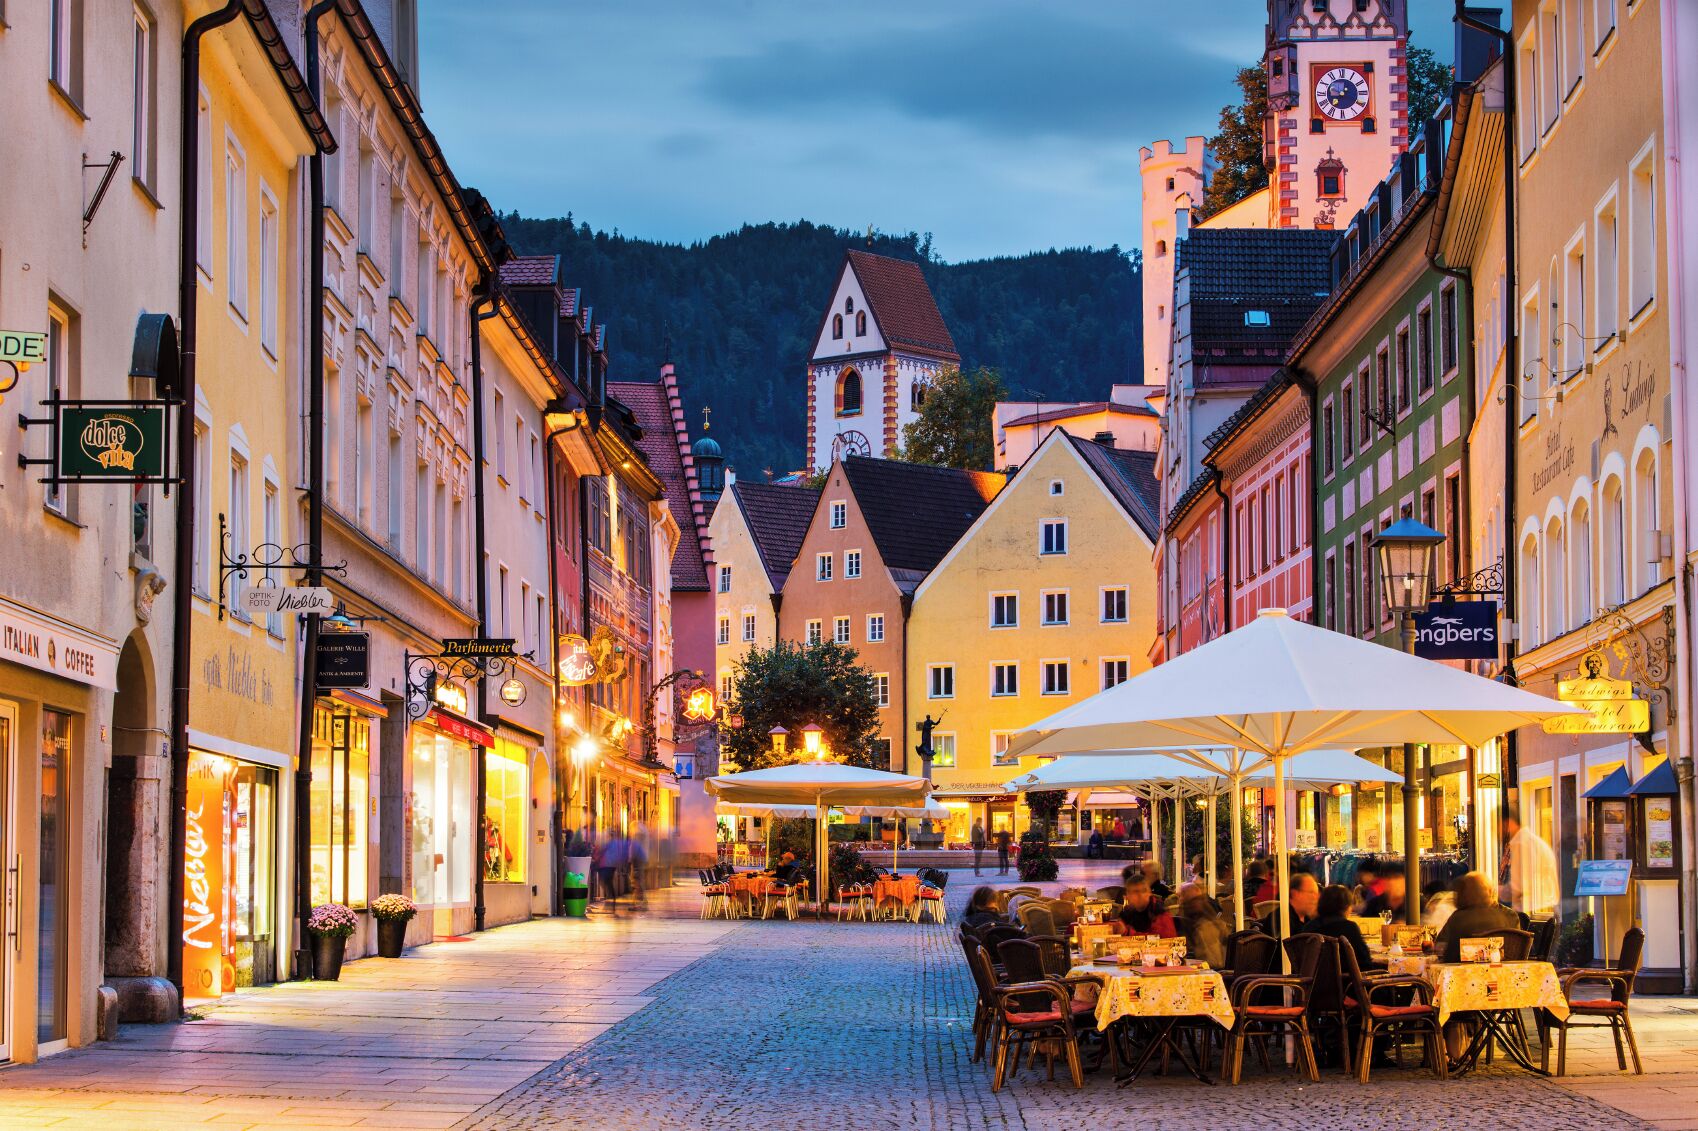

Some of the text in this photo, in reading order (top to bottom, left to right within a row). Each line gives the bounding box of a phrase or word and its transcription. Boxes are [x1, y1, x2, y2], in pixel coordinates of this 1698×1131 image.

[0, 336, 39, 357] DE
[84, 419, 126, 447] dolce
[98, 442, 134, 470] vita
[1414, 623, 1494, 646] engbers
[4, 625, 95, 677] ITALIAN COFFEE
[446, 639, 511, 655] Parfümerie
[1567, 684, 1626, 698] Ludwigs
[1548, 719, 1645, 731] Restaurant
